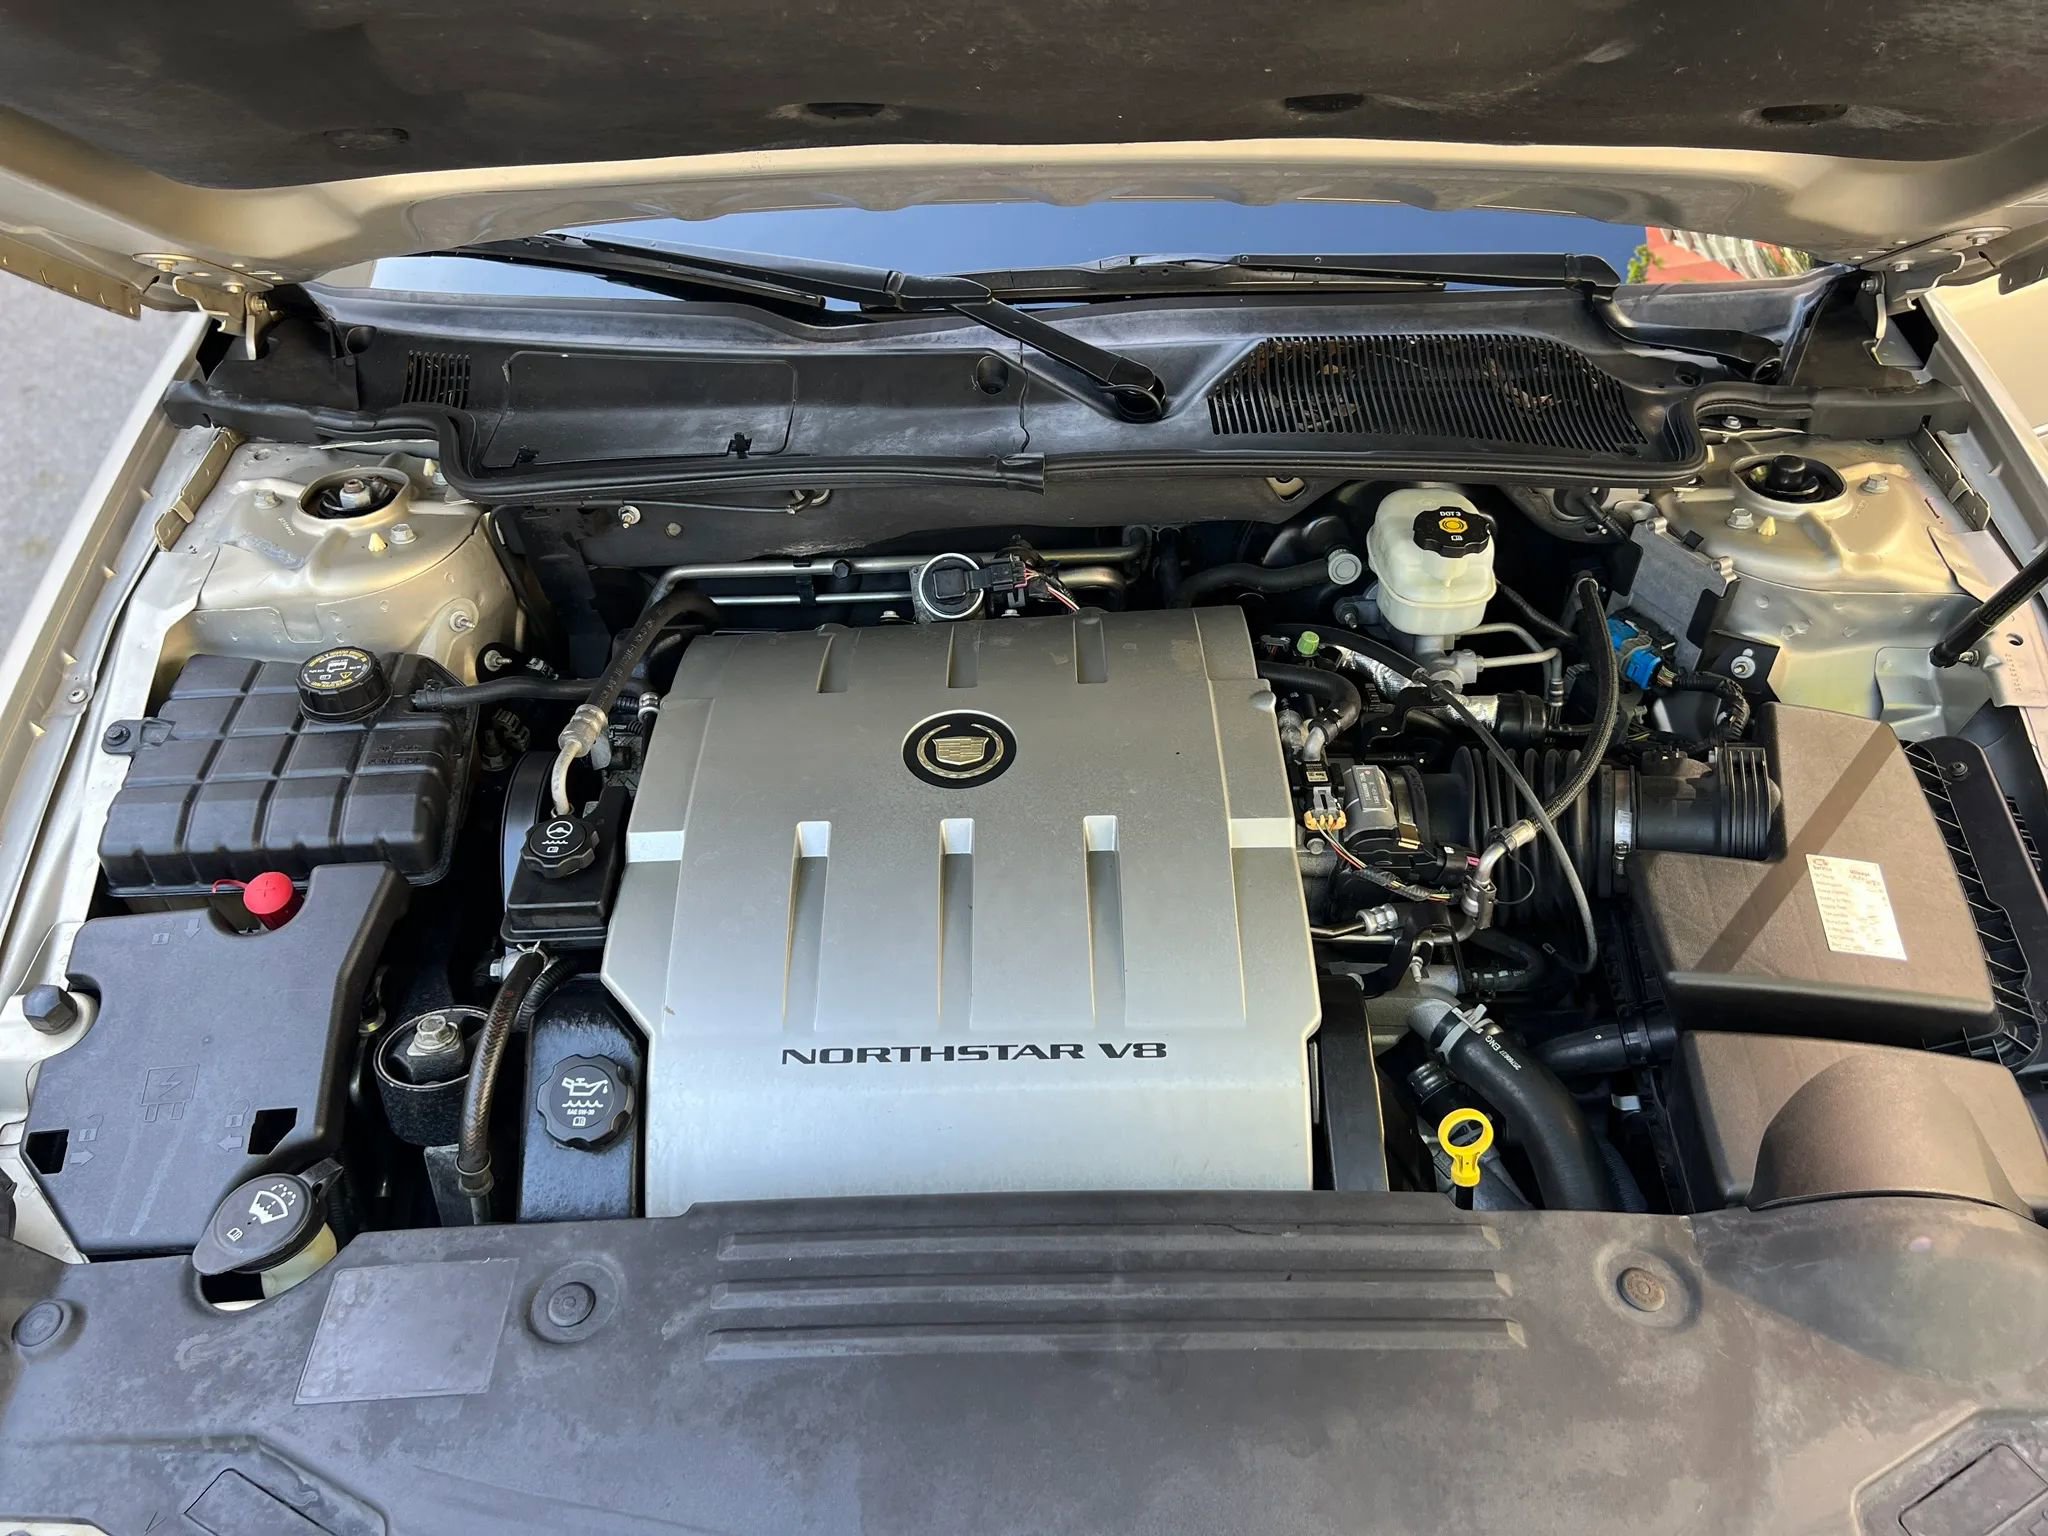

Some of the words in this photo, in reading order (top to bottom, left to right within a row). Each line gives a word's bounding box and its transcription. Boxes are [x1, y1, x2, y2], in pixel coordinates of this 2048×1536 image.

[1485, 1035, 1501, 1051] ENG
[781, 1043, 1086, 1065] NORTHSTAR
[1098, 1042, 1167, 1059] V8
